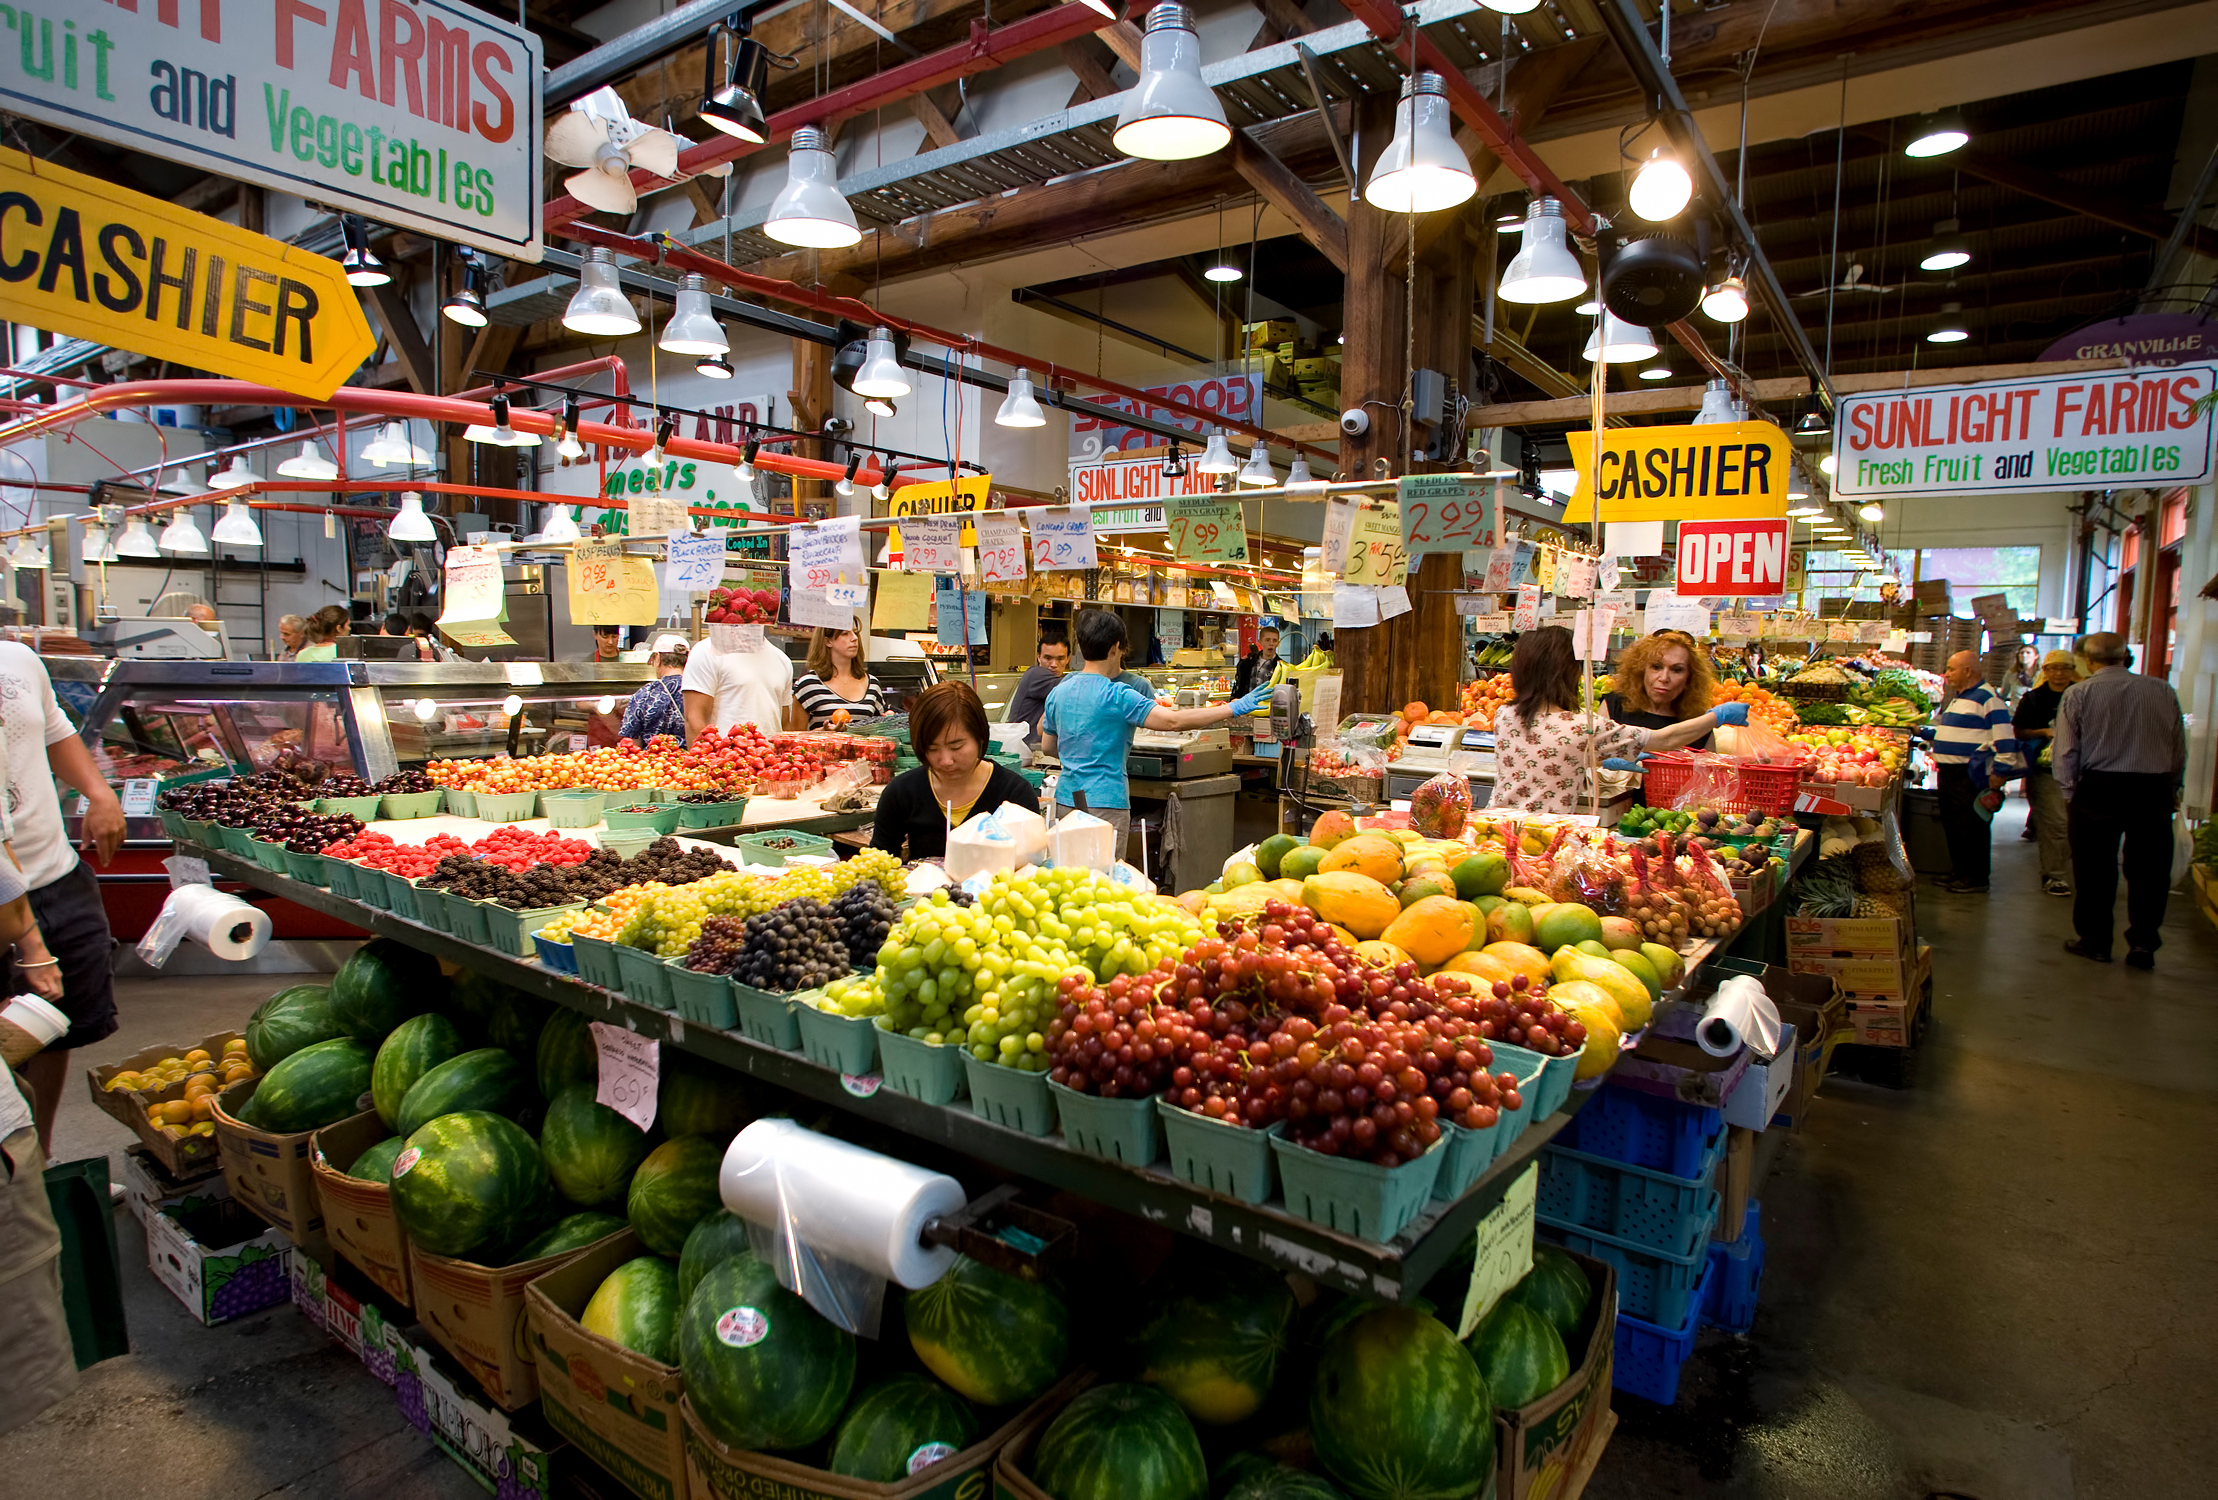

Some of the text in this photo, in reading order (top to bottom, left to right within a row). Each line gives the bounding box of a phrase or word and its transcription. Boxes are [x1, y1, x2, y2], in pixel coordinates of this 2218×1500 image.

[275, 0, 515, 144] FARMS
[150, 59, 236, 140] and
[263, 82, 494, 218] Vegetables
[0, 191, 319, 364] CASHIER
[2076, 335, 2202, 359] GRANVILLE
[1849, 376, 2200, 451] SUNLIGHT FARMS
[605, 460, 697, 496] meats
[1599, 443, 1771, 501] CASHIER
[1857, 444, 2180, 487] Fresh Fruit and Vegetables
[1078, 464, 1163, 502] SUNLIGHT
[1407, 488, 1425, 497] RED
[1428, 487, 1466, 496] GRAPES
[1145, 507, 1162, 522] and
[1174, 508, 1198, 517] GREEN
[980, 527, 1019, 537] CHAMPAGNE
[981, 538, 1005, 547] GRAPES
[1472, 529, 1494, 548] LB
[1349, 541, 1367, 575] 3
[1681, 532, 1783, 584] OPEN
[1788, 919, 1822, 932] Dole
[1791, 960, 1825, 973] Dole
